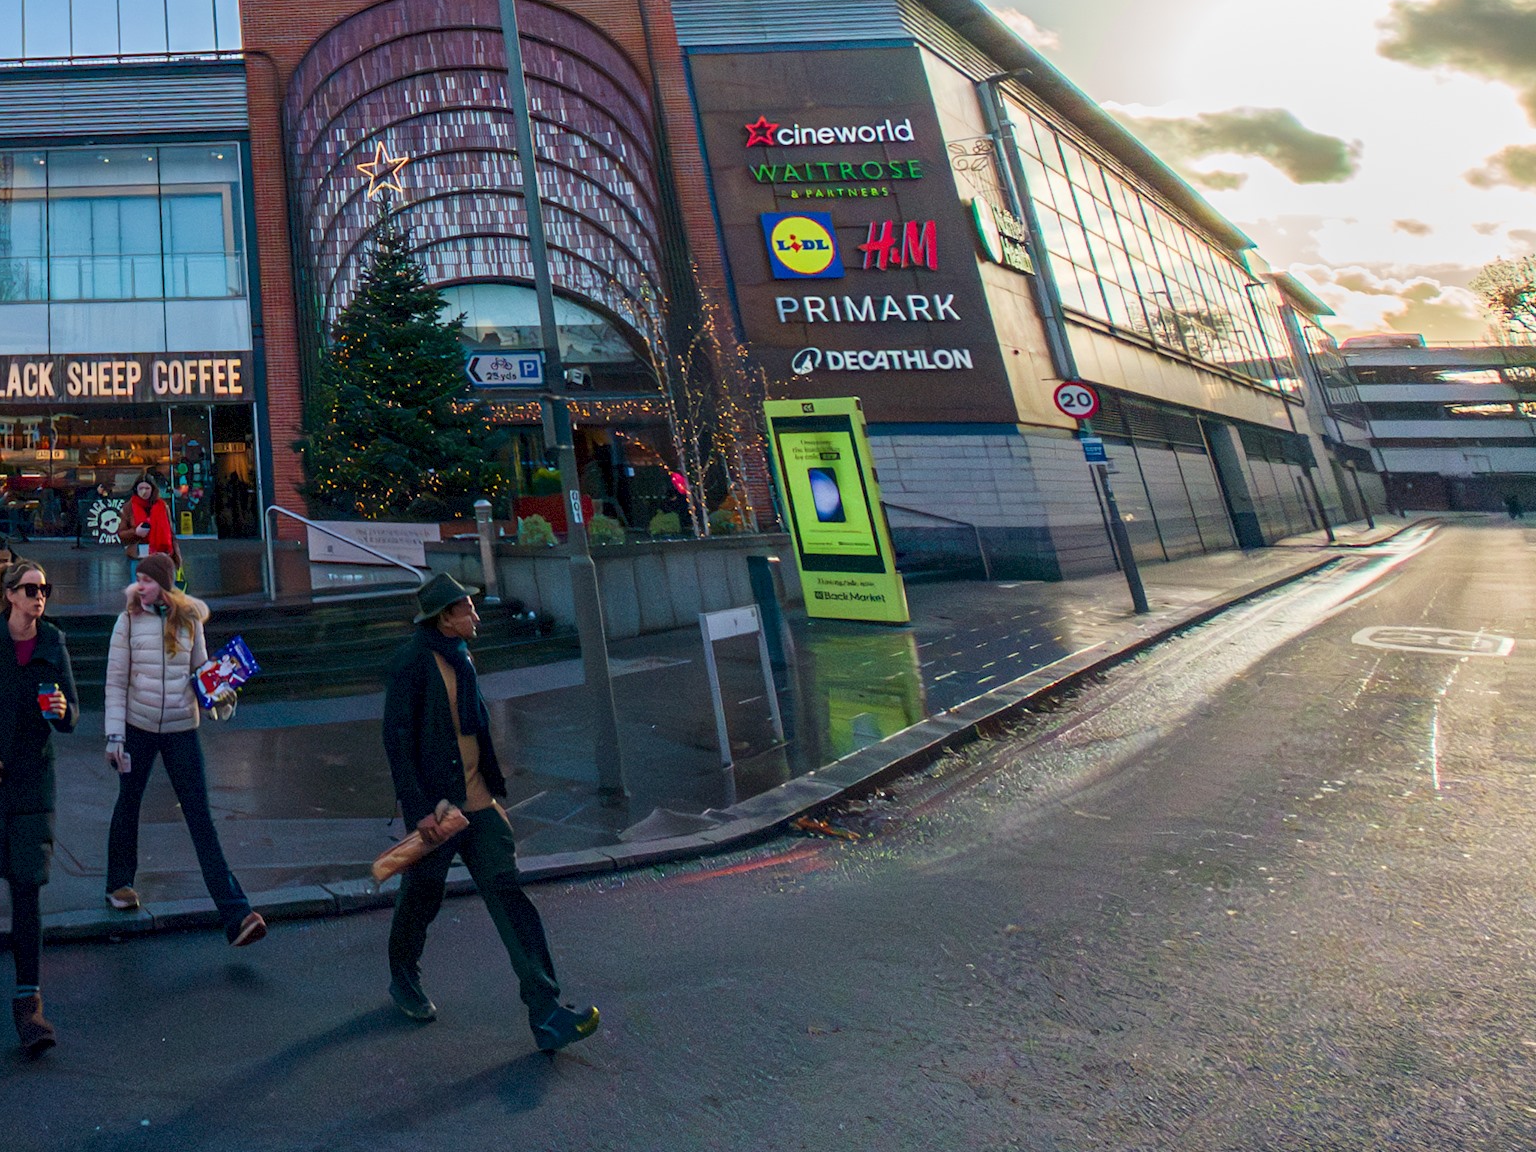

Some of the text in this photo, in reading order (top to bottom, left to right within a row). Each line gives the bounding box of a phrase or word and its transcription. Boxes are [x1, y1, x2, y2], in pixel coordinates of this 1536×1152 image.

[776, 118, 914, 146] cineworld
[749, 159, 924, 183] WAITROSE
[790, 186, 889, 199] & PARTNERS
[858, 219, 938, 271] H&M
[775, 294, 962, 323] PRIMARK
[523, 362, 535, 376] P
[825, 349, 974, 371] DECATHLON
[66, 360, 142, 396] SHEEP
[152, 358, 243, 395] COFFEE
[1060, 392, 1092, 408] 20
[86, 499, 107, 527] BLACK
